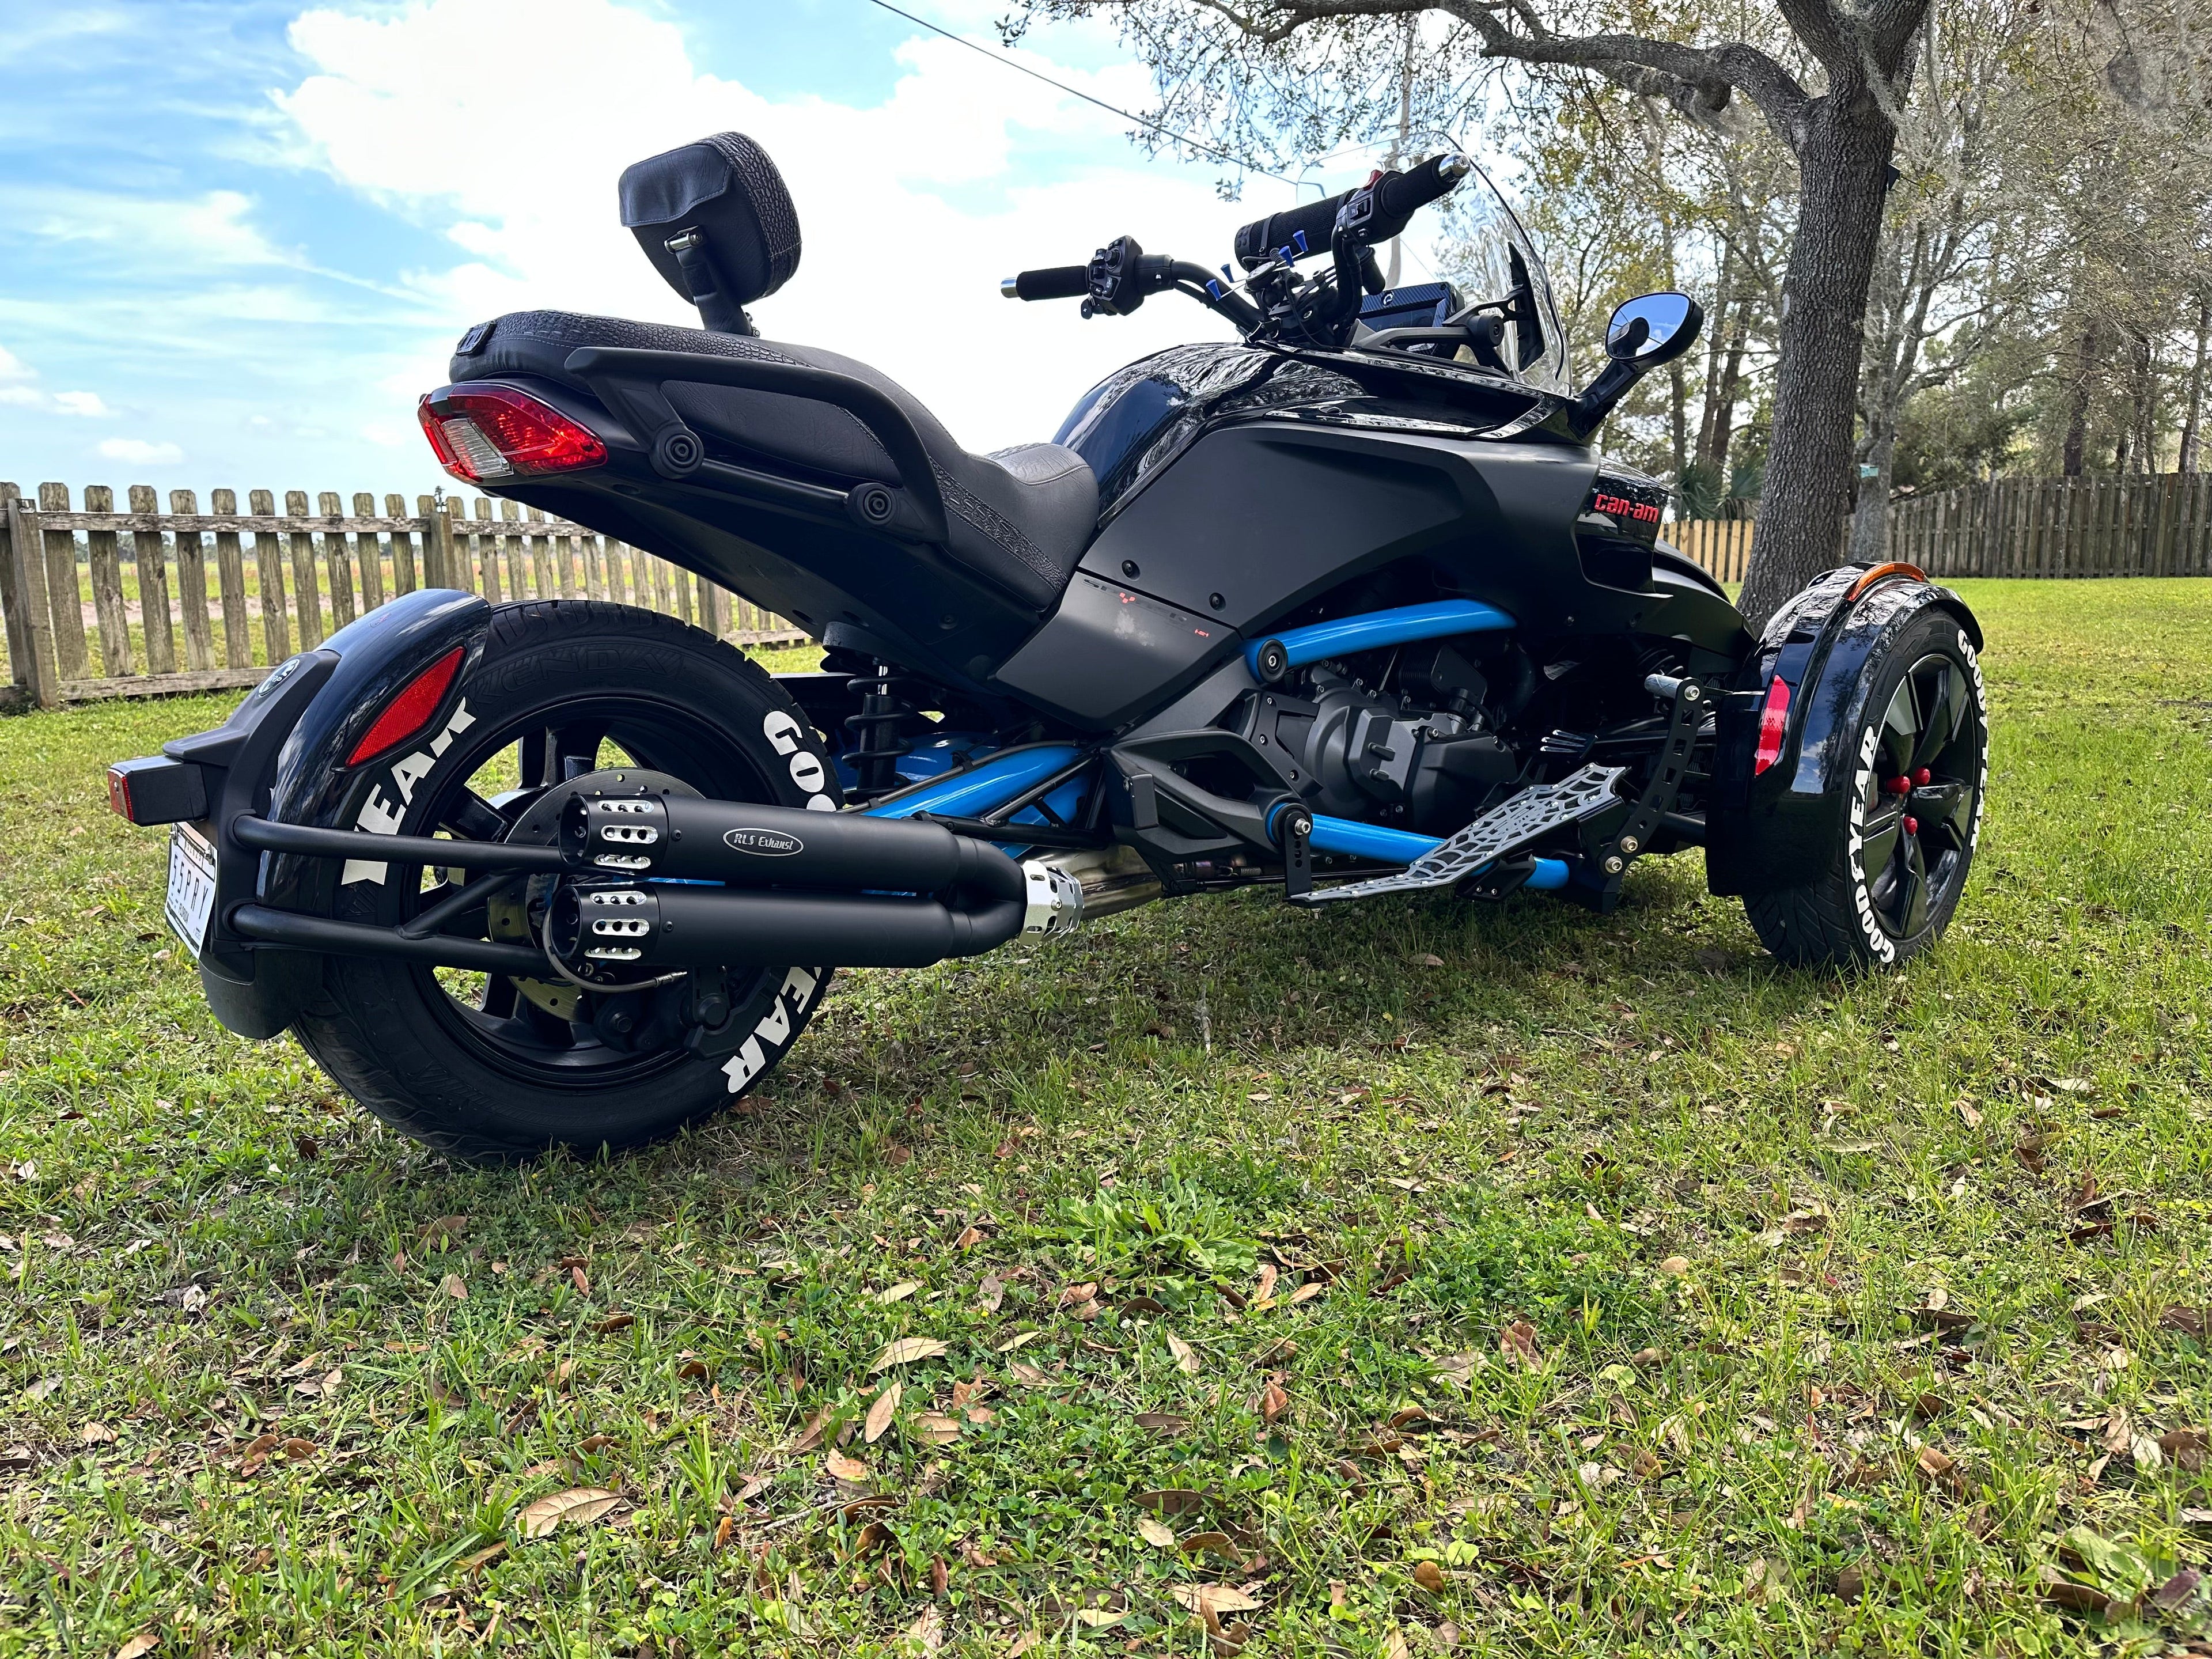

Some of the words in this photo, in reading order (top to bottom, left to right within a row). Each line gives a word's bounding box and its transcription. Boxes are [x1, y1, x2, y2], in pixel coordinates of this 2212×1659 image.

[1594, 494, 1659, 523] can-am
[733, 833, 756, 846] RLS
[757, 836, 794, 850] Exhaust
[1849, 725, 1895, 963] GOODYEAR
[721, 967, 823, 1093] EAR
